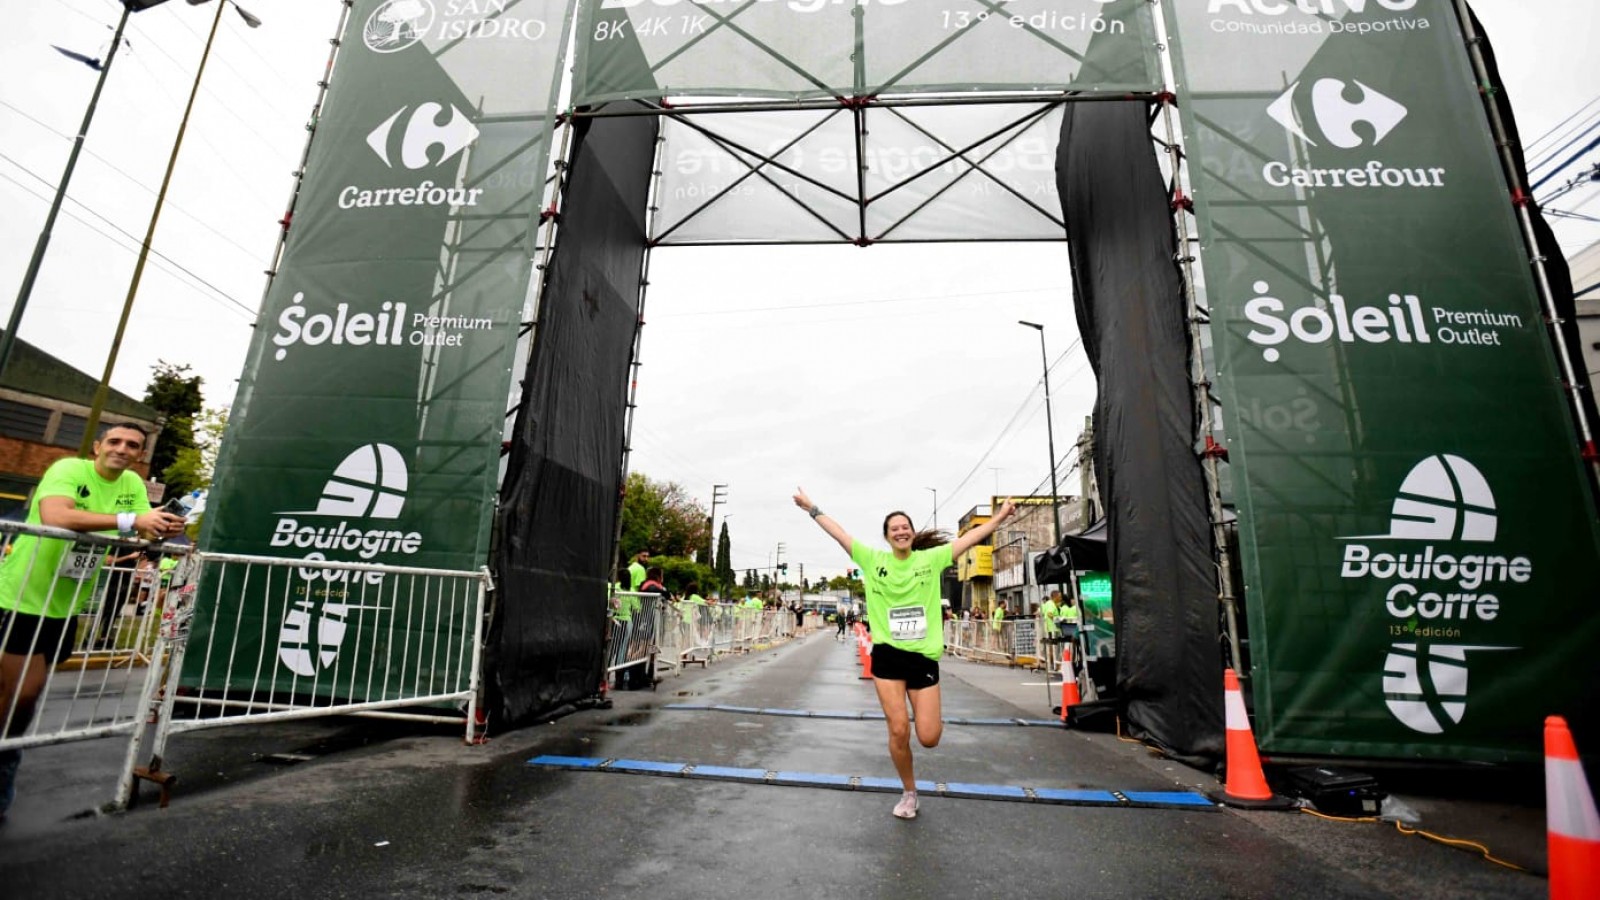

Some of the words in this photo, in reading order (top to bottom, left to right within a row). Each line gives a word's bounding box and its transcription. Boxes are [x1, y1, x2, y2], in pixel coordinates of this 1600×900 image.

[437, 18, 546, 40] ISIDRO
[593, 19, 628, 41] 8K
[635, 16, 671, 37] 4K
[681, 14, 710, 35] 1K
[1009, 10, 1125, 34] edición
[1210, 18, 1323, 35] Comunidad
[1329, 16, 1431, 36] Deportiva
[1262, 160, 1446, 188] Carrefour
[338, 180, 484, 209] Carrefour
[272, 291, 407, 361] Soleil
[413, 313, 492, 330] Premium
[1244, 280, 1431, 362] Soleil
[1432, 307, 1523, 328] Premium
[409, 330, 463, 347] Outlet
[1437, 327, 1502, 346] Outlet
[270, 518, 423, 559] Boulogne
[1341, 544, 1532, 590] Boulogne
[1386, 583, 1500, 621] Corre
[896, 620, 918, 631] 777
[1415, 624, 1461, 638] edición
